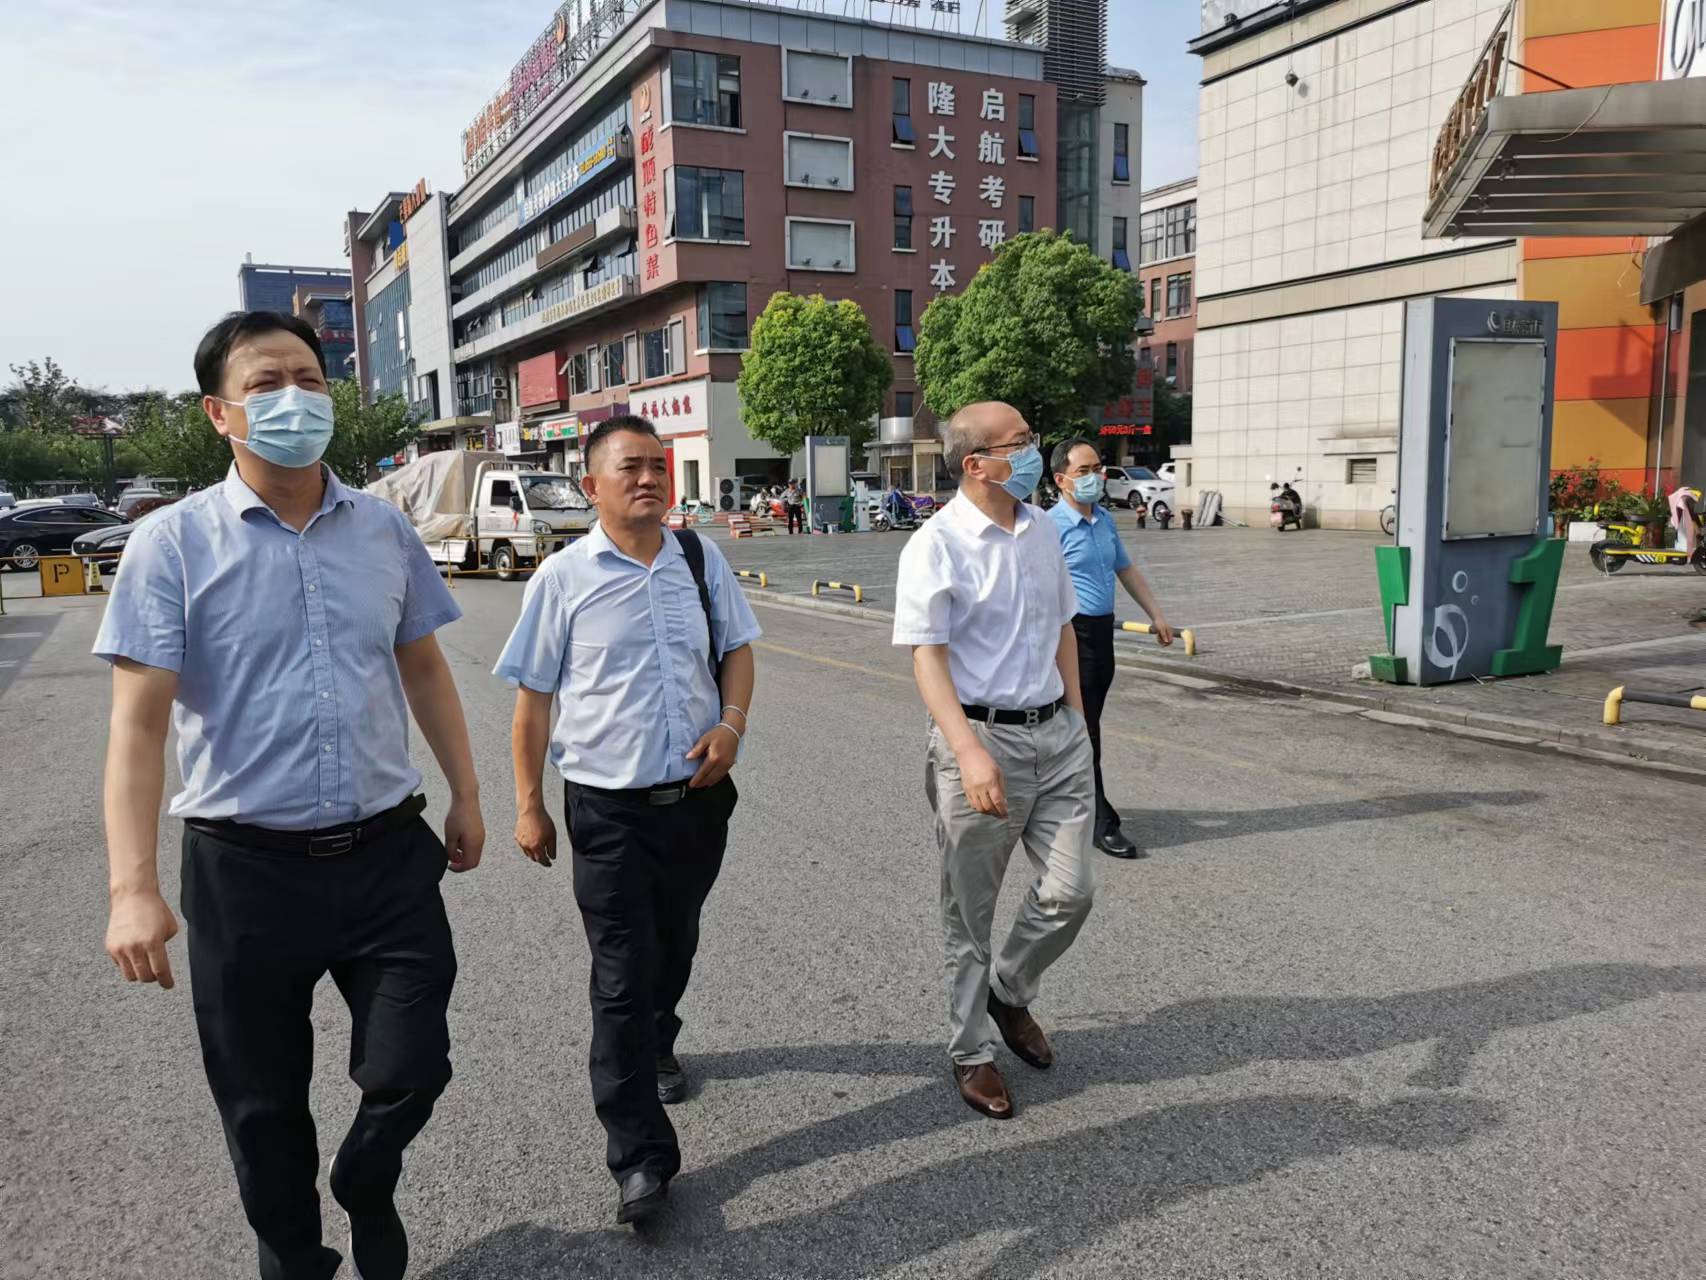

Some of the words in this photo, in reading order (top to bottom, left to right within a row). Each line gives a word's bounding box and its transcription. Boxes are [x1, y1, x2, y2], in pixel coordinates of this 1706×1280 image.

[927, 81, 957, 291] 隆大专升本
[977, 87, 1006, 252] 启航考研
[53, 563, 70, 583] P
